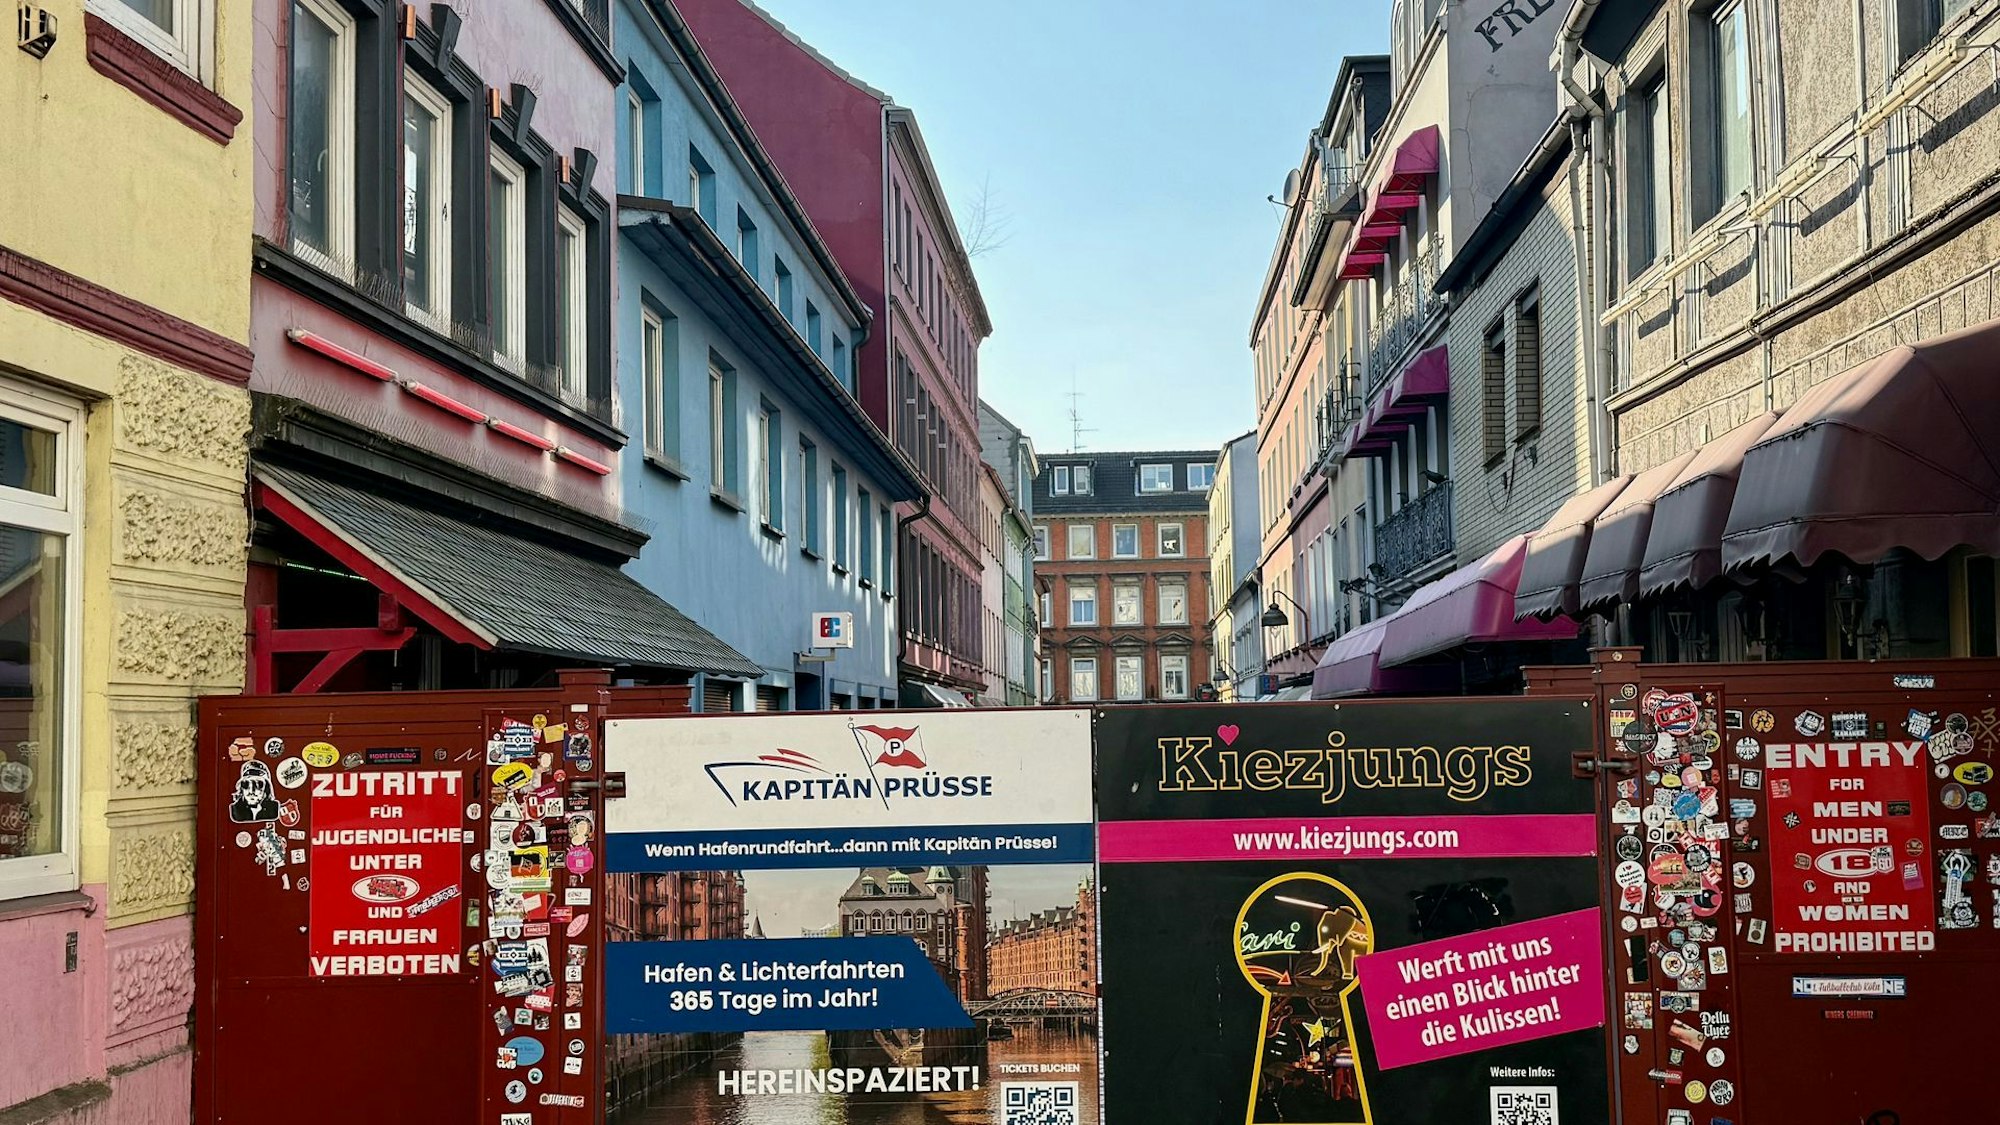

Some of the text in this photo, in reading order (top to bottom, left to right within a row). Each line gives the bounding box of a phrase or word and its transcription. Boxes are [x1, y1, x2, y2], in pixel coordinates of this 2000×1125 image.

[1907, 722, 1929, 737] HSV
[890, 740, 901, 754] P
[1766, 742, 1924, 768] ENTRY
[1157, 730, 1532, 804] Kiezjungs
[312, 771, 462, 797] ZUTRITT
[742, 772, 992, 801] KAPITÄN PRÜSSE
[1830, 778, 1864, 791] FOR
[370, 804, 402, 818] FÜR
[1813, 801, 1882, 818] MEN
[312, 828, 462, 846] JUGENDLICHE
[1233, 825, 1459, 855] www.kiezjungs.com
[1811, 828, 1888, 844] UNDER
[645, 842, 695, 858] Wenn
[891, 837, 920, 853] mit
[924, 835, 992, 855] Kapitän
[995, 834, 1057, 850] Prüsse!
[350, 854, 422, 870] UNTER
[1830, 855, 1872, 870] 18
[1834, 882, 1870, 894] AND
[368, 906, 402, 918] UND
[1798, 905, 1909, 921] WOMEN
[333, 929, 437, 945] FRAUEN
[1775, 931, 1935, 952] PROHIBITED
[311, 954, 460, 975] VERBOTEN
[1397, 935, 1553, 985] Werft mit uns
[645, 959, 905, 984] Hafen & Lichterfahrten
[1386, 960, 1581, 1021] einen Blick hinter
[1864, 982, 1881, 991] Köln
[669, 987, 878, 1015] 365 Tage im Jahr!
[1421, 996, 1561, 1048] die Kulissen!
[1000, 1063, 1080, 1074] TICKETS BUCHEN
[1490, 1067, 1555, 1078] Weitere Infos:
[718, 1065, 980, 1095] HEREINSPAZIERT!
